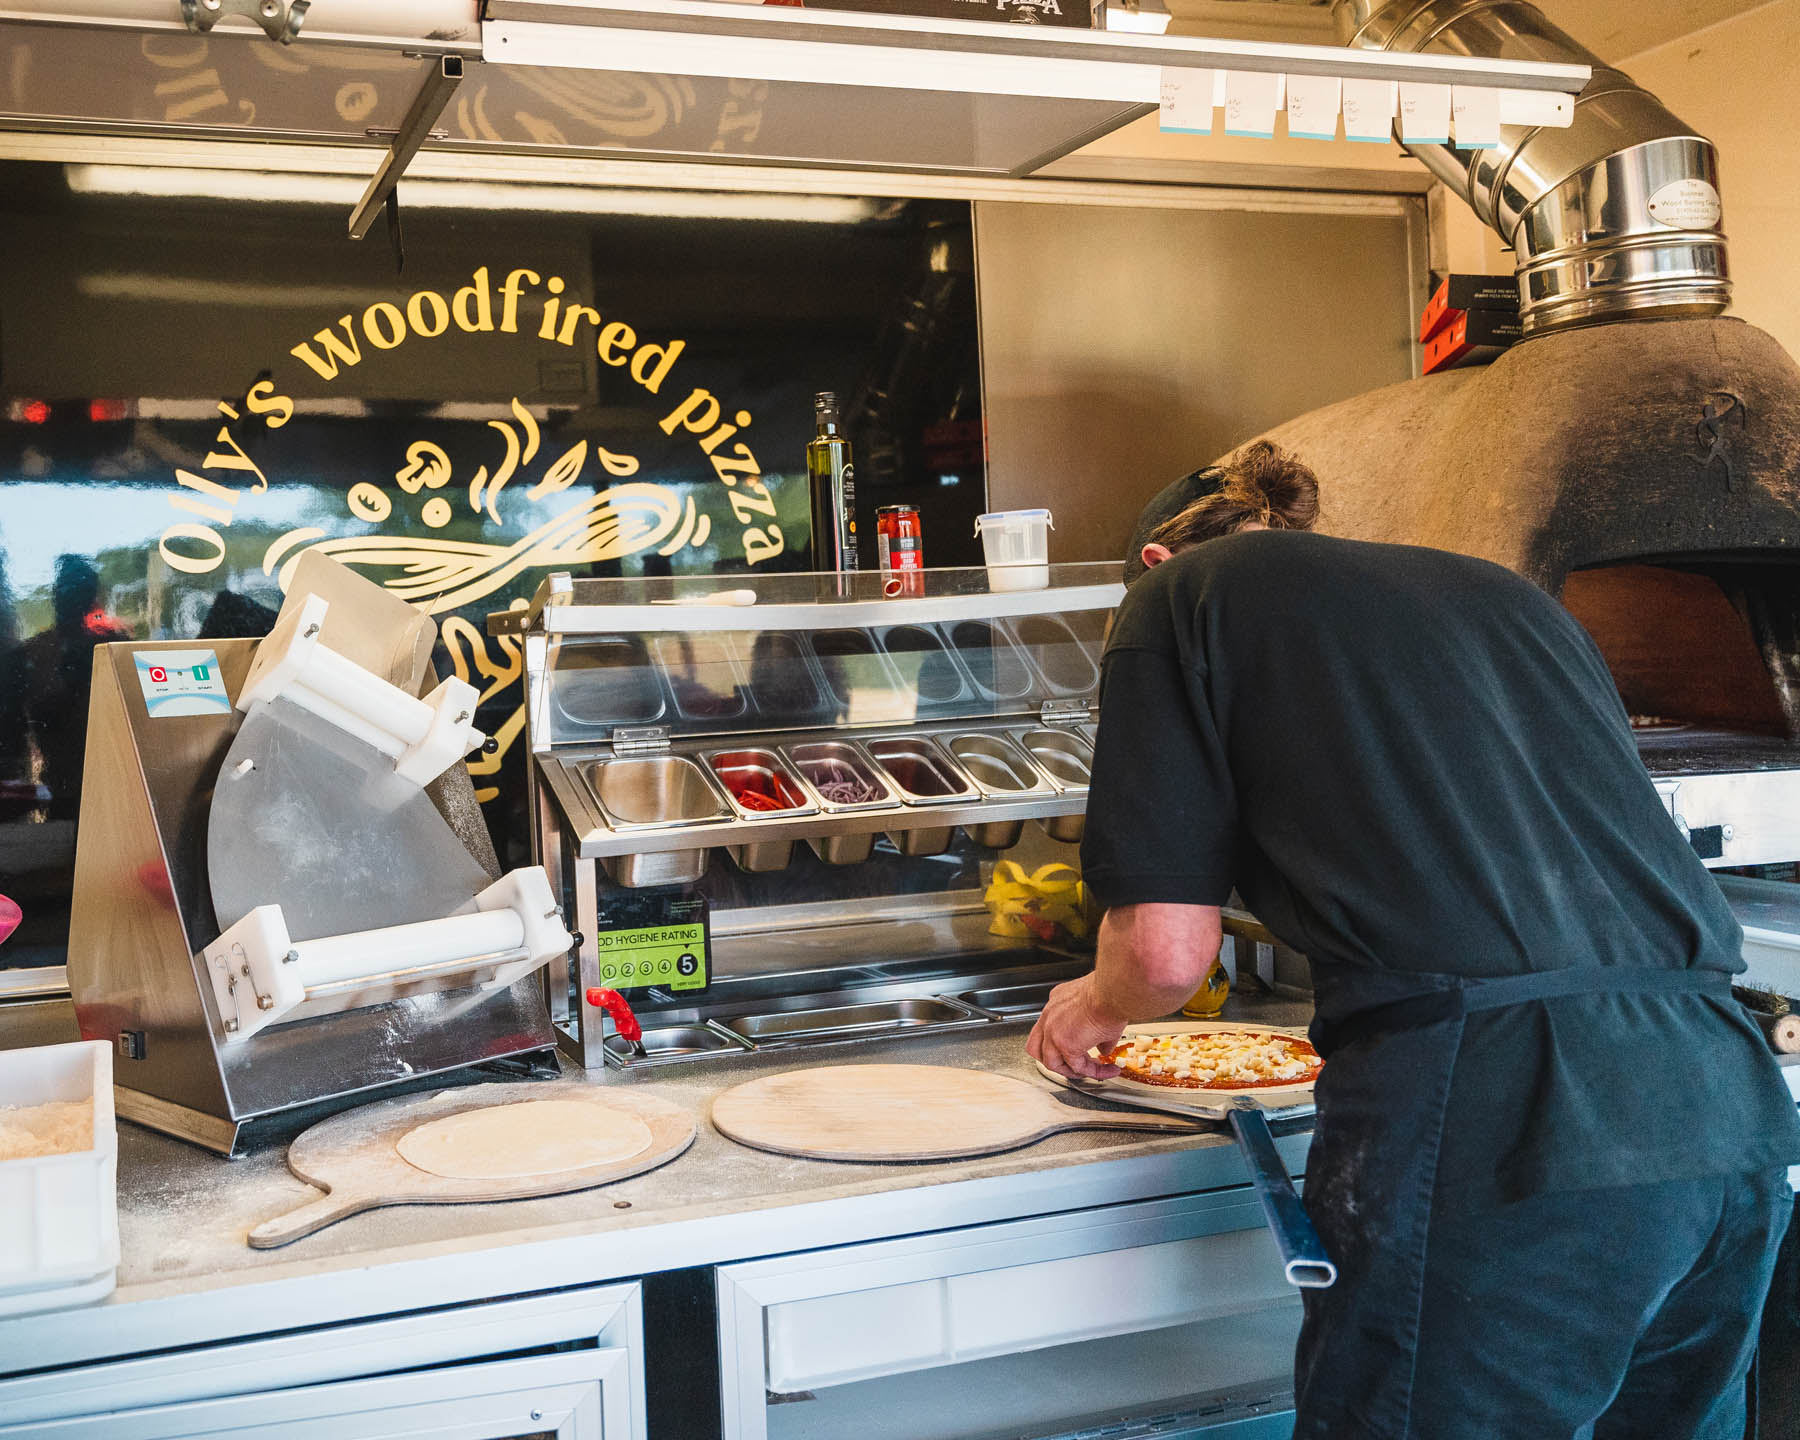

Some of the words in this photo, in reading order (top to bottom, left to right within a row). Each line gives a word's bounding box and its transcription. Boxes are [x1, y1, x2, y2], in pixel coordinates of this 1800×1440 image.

[159, 380, 295, 574] Olly's
[291, 267, 686, 394] woodfired
[659, 388, 784, 566] pizza
[598, 937, 613, 946] OD
[616, 932, 659, 945] HYGIENE
[661, 929, 698, 941] RATING
